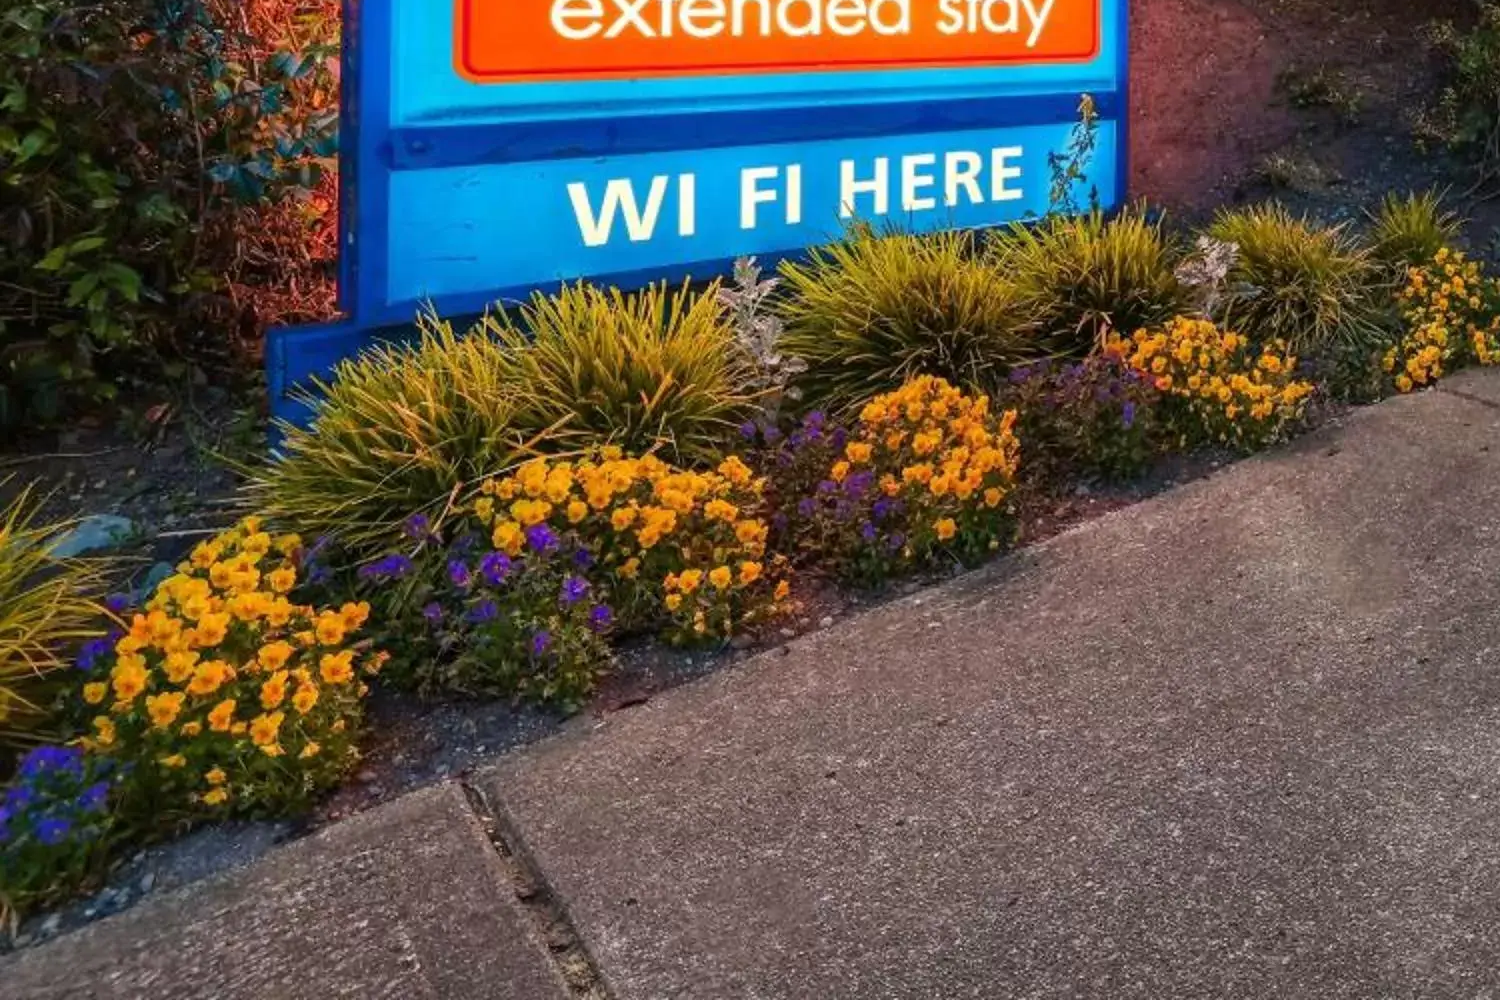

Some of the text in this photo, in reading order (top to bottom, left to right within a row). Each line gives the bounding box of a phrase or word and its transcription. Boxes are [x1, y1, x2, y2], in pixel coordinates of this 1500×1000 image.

[567, 146, 1023, 247] WI FI HERE
